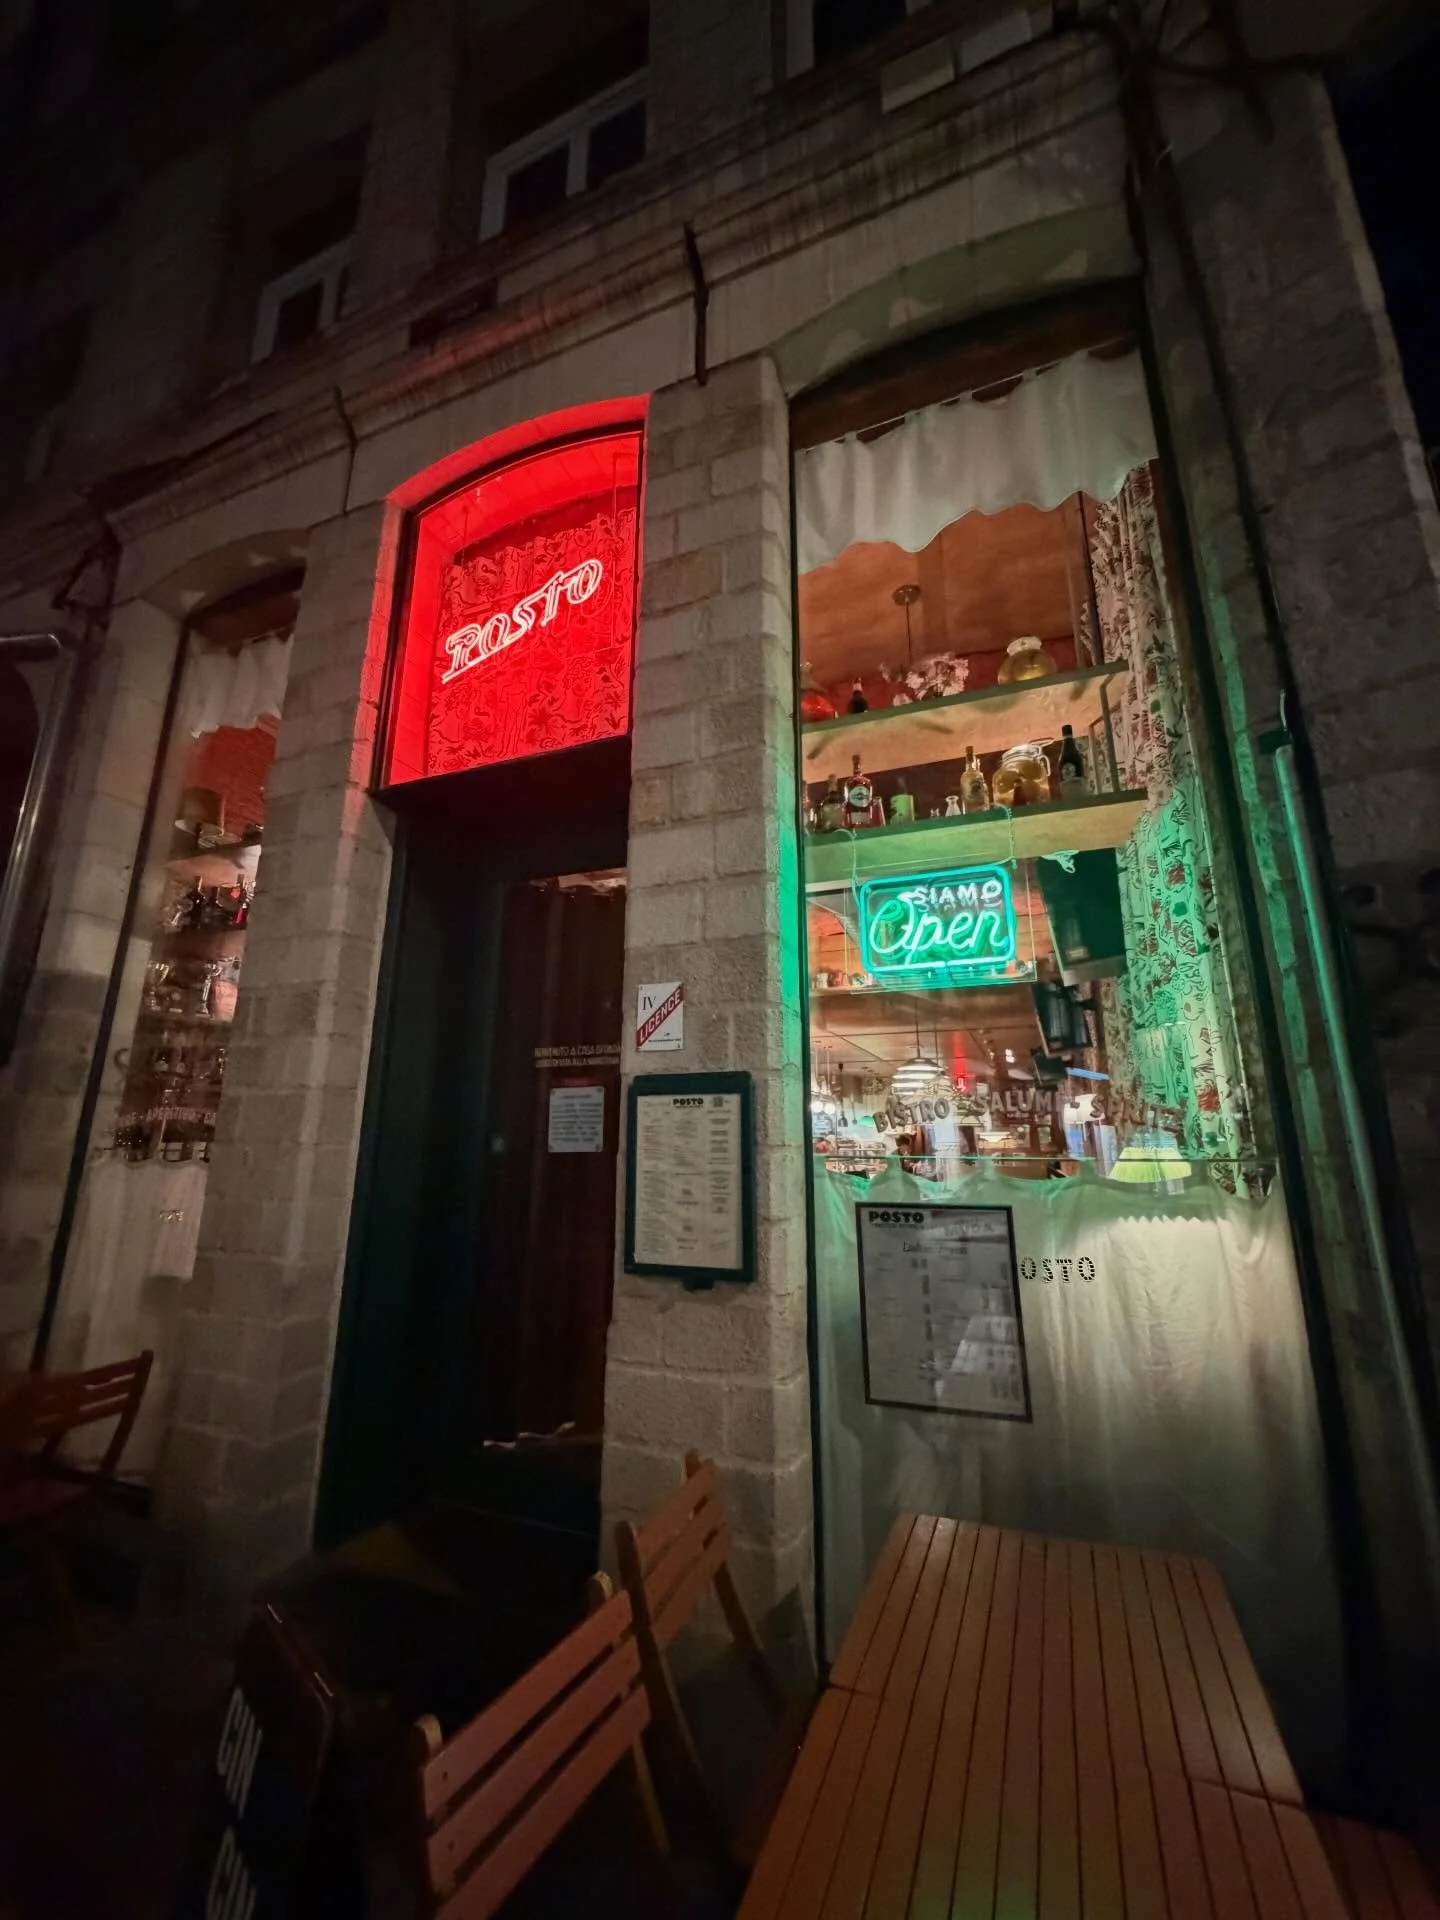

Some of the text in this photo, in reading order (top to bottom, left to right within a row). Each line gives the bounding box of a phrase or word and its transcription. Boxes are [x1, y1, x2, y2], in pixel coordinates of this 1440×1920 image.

[441, 559, 603, 684] POSTO
[914, 880, 1002, 905] SIAMO
[869, 893, 1009, 966] Open
[640, 988, 682, 1043] LICENCE
[673, 1098, 704, 1106] POSTO
[873, 1096, 950, 1133] BISTRO
[868, 1210, 925, 1223] POSTO
[1020, 1256, 1096, 1283] OSTO
